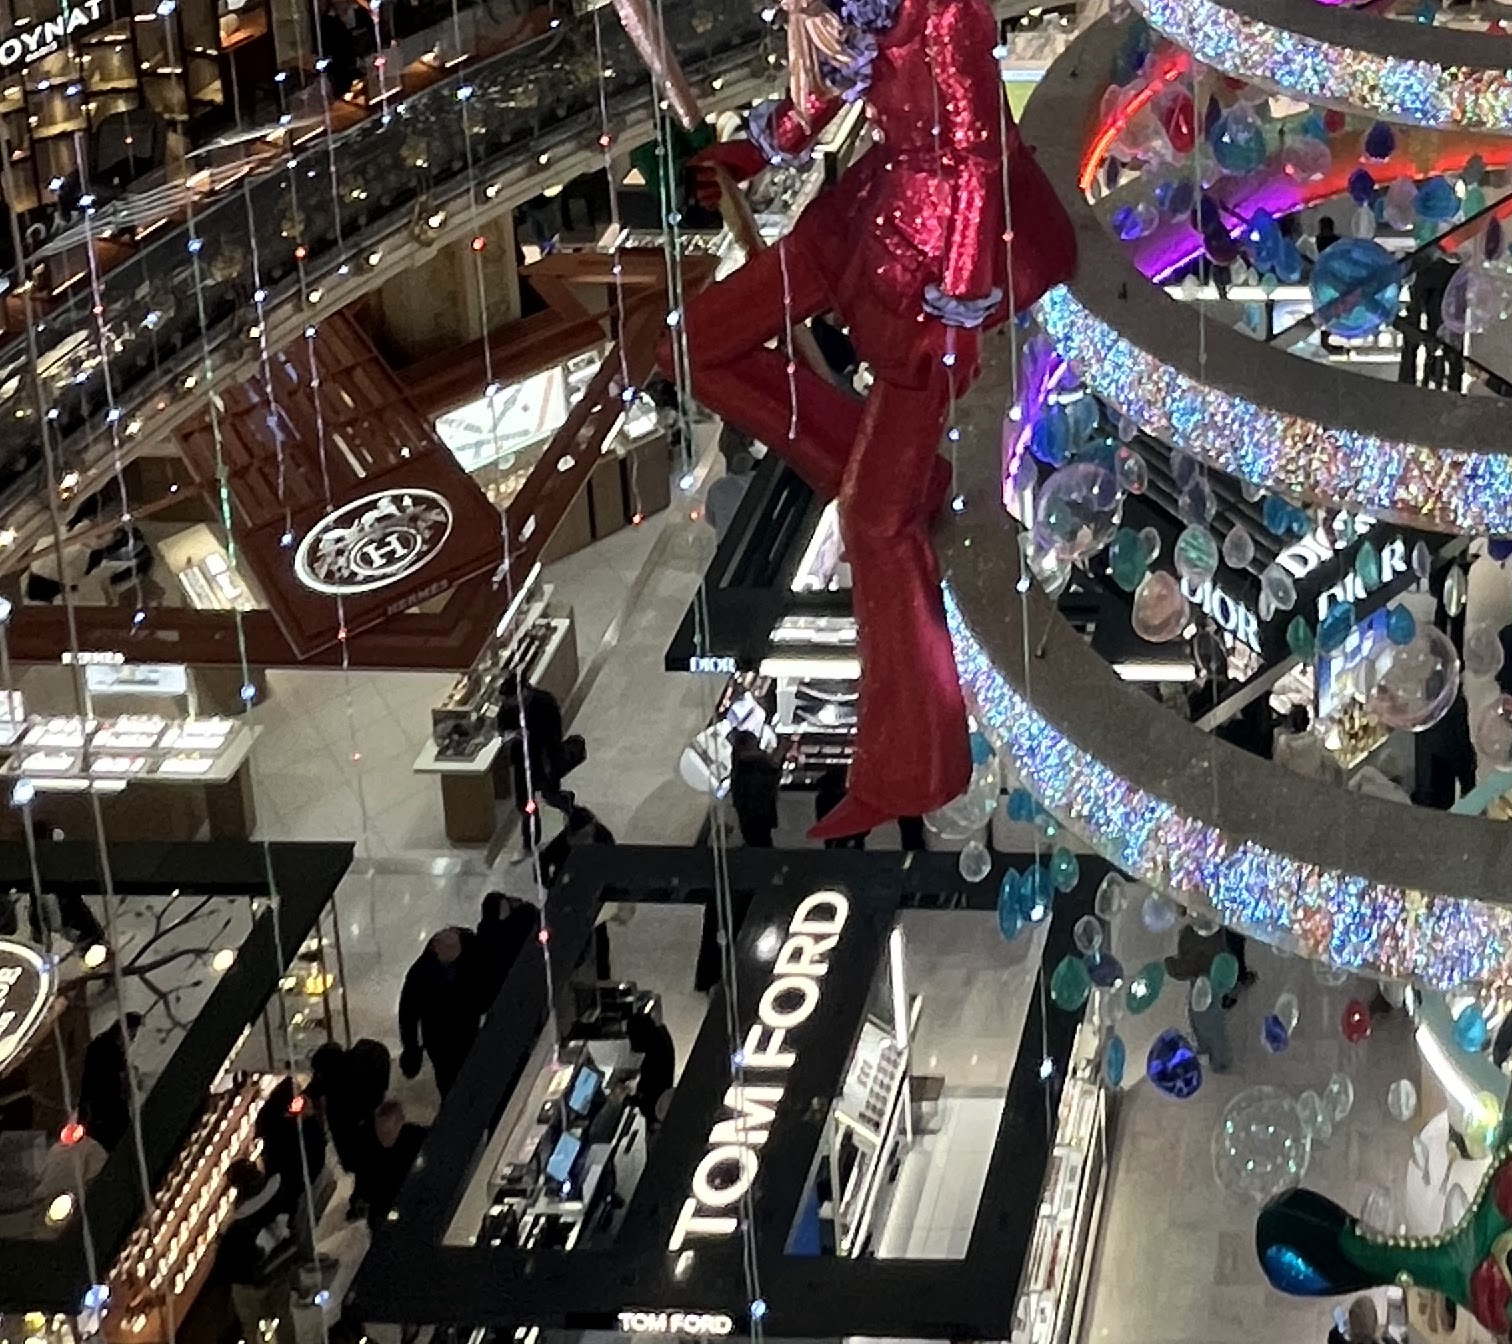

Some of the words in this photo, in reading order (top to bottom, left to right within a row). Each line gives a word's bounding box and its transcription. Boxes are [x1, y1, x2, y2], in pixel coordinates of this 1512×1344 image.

[362, 532, 408, 569] H
[668, 1085, 785, 1252] TOM
[742, 889, 850, 1069] FORD
[618, 1312, 667, 1332] TOM
[670, 1313, 733, 1334] FORD
